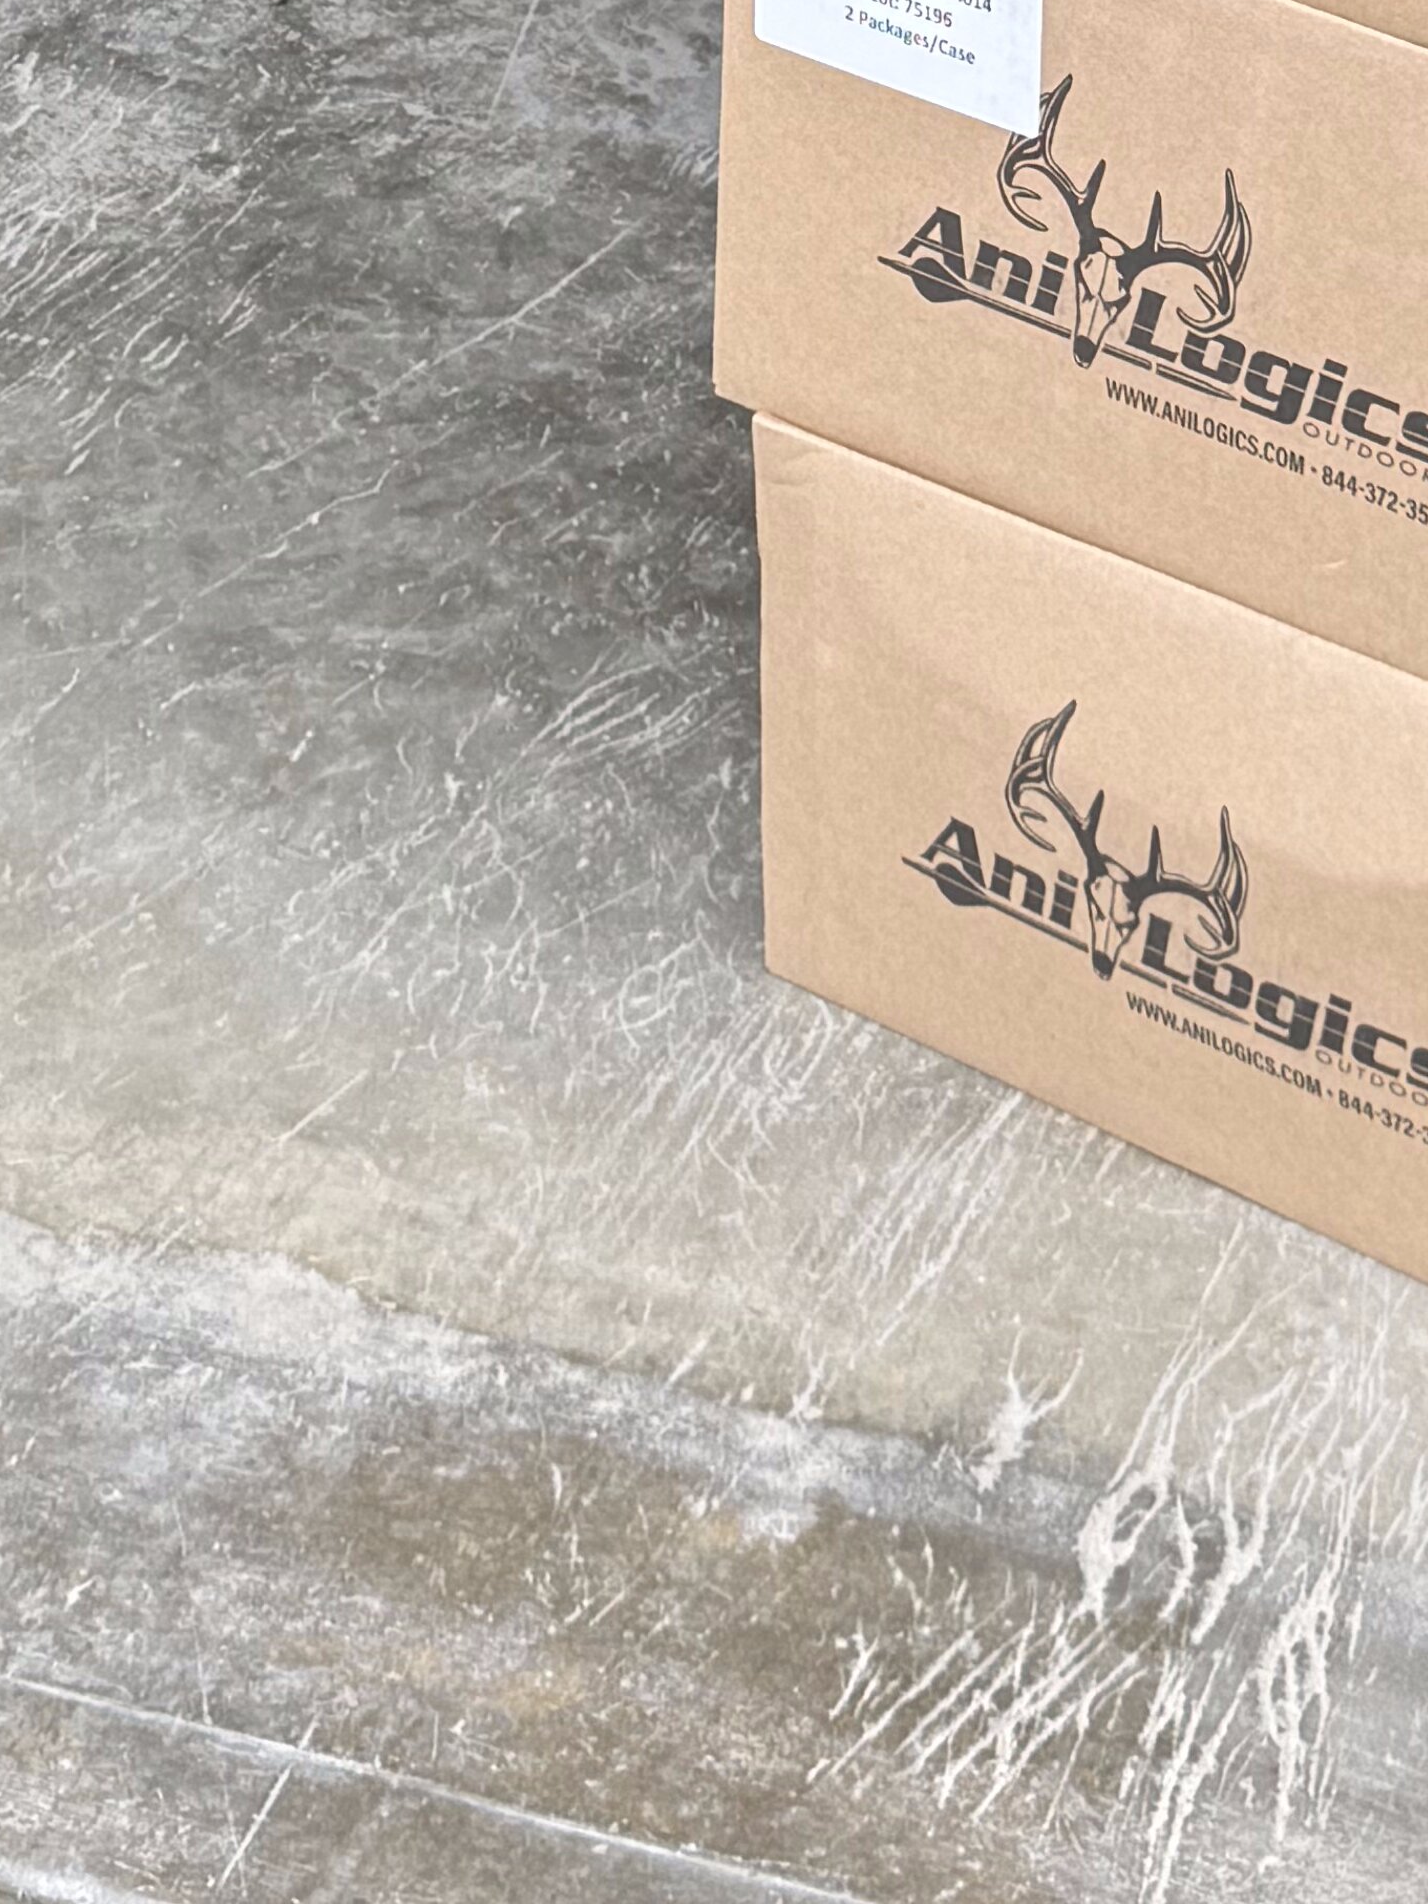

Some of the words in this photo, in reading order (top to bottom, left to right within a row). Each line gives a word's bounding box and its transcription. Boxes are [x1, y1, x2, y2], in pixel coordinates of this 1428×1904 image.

[843, 4, 855, 22] 2
[858, 10, 977, 66] Packages/Case
[897, 205, 1069, 317] Ani
[1104, 375, 1307, 478] WWW.ANILOGICS.COM
[919, 815, 1080, 930] Ani
[1124, 990, 1323, 1099] WWW.ANILOGICS.COM
